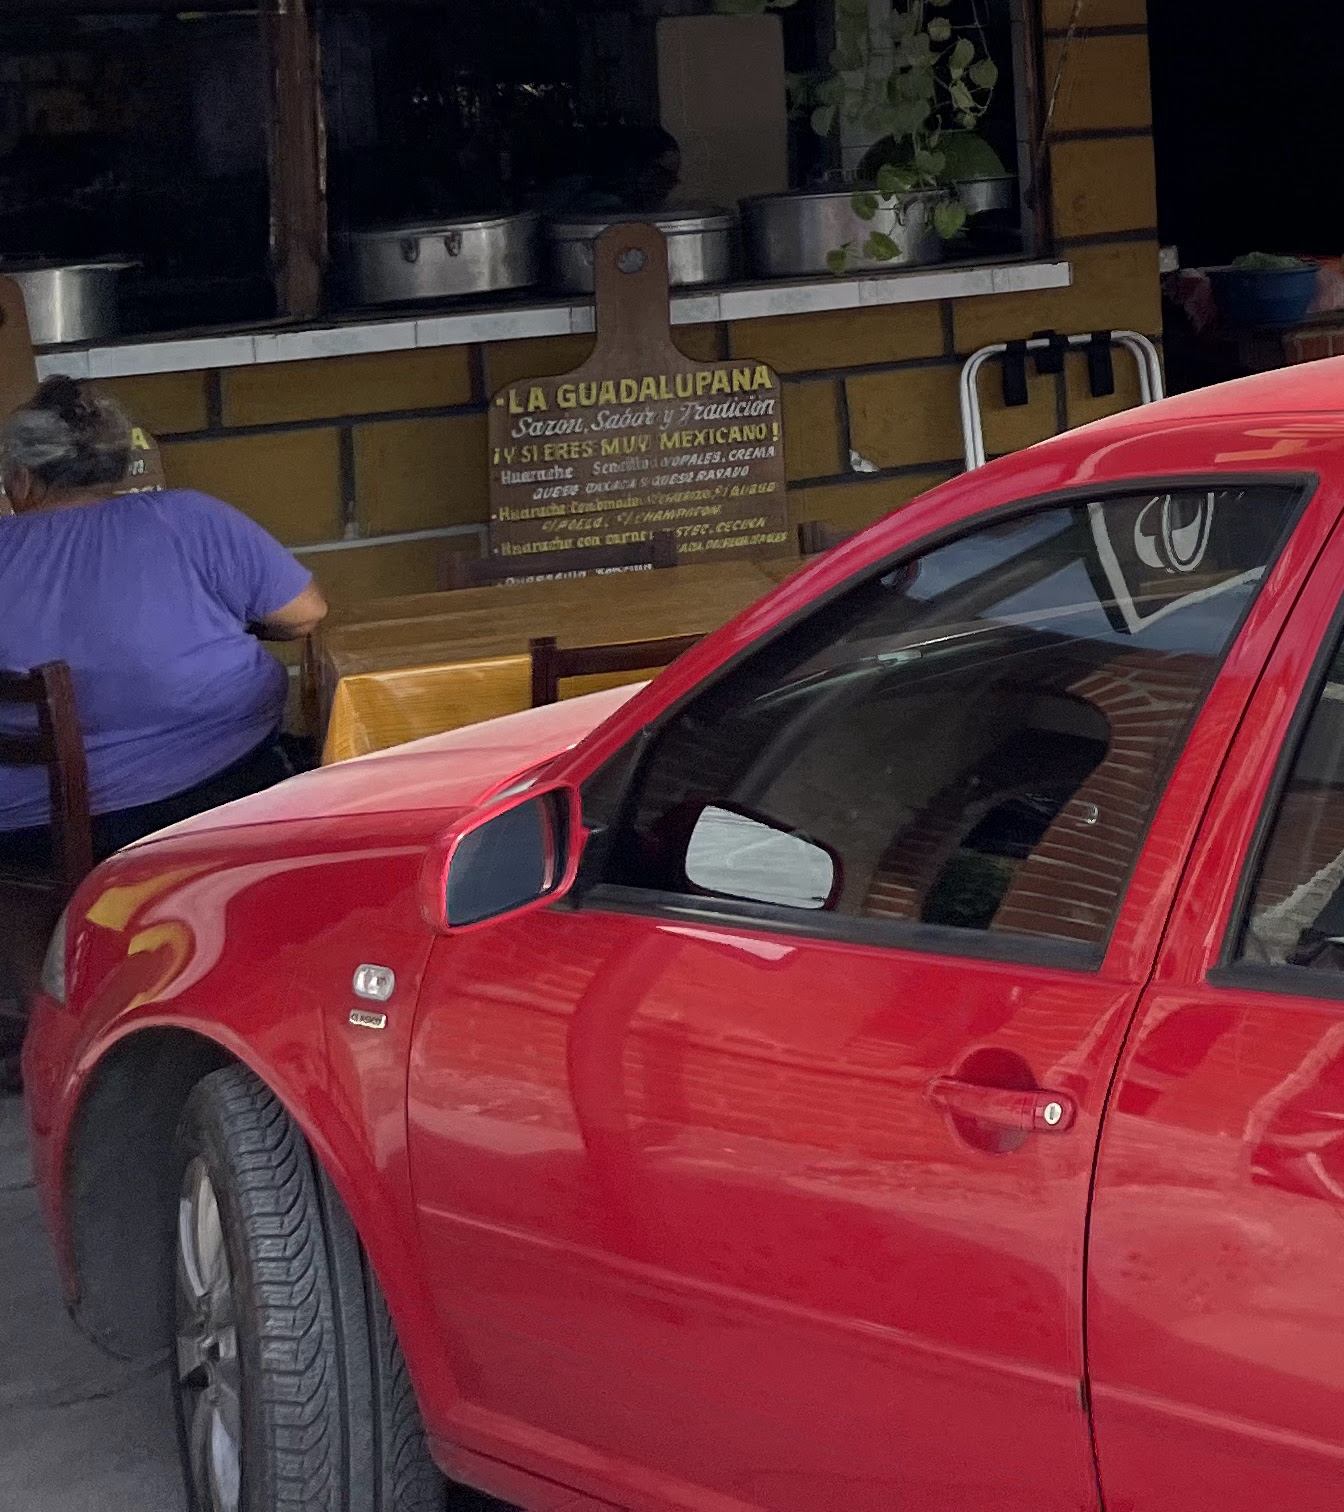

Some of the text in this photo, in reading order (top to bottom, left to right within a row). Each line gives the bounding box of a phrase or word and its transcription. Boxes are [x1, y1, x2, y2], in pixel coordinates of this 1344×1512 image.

[557, 365, 772, 408] GUADALUPANA
[544, 439, 593, 461] ERES
[601, 433, 651, 456] MUY
[728, 444, 776, 463] CREMA
